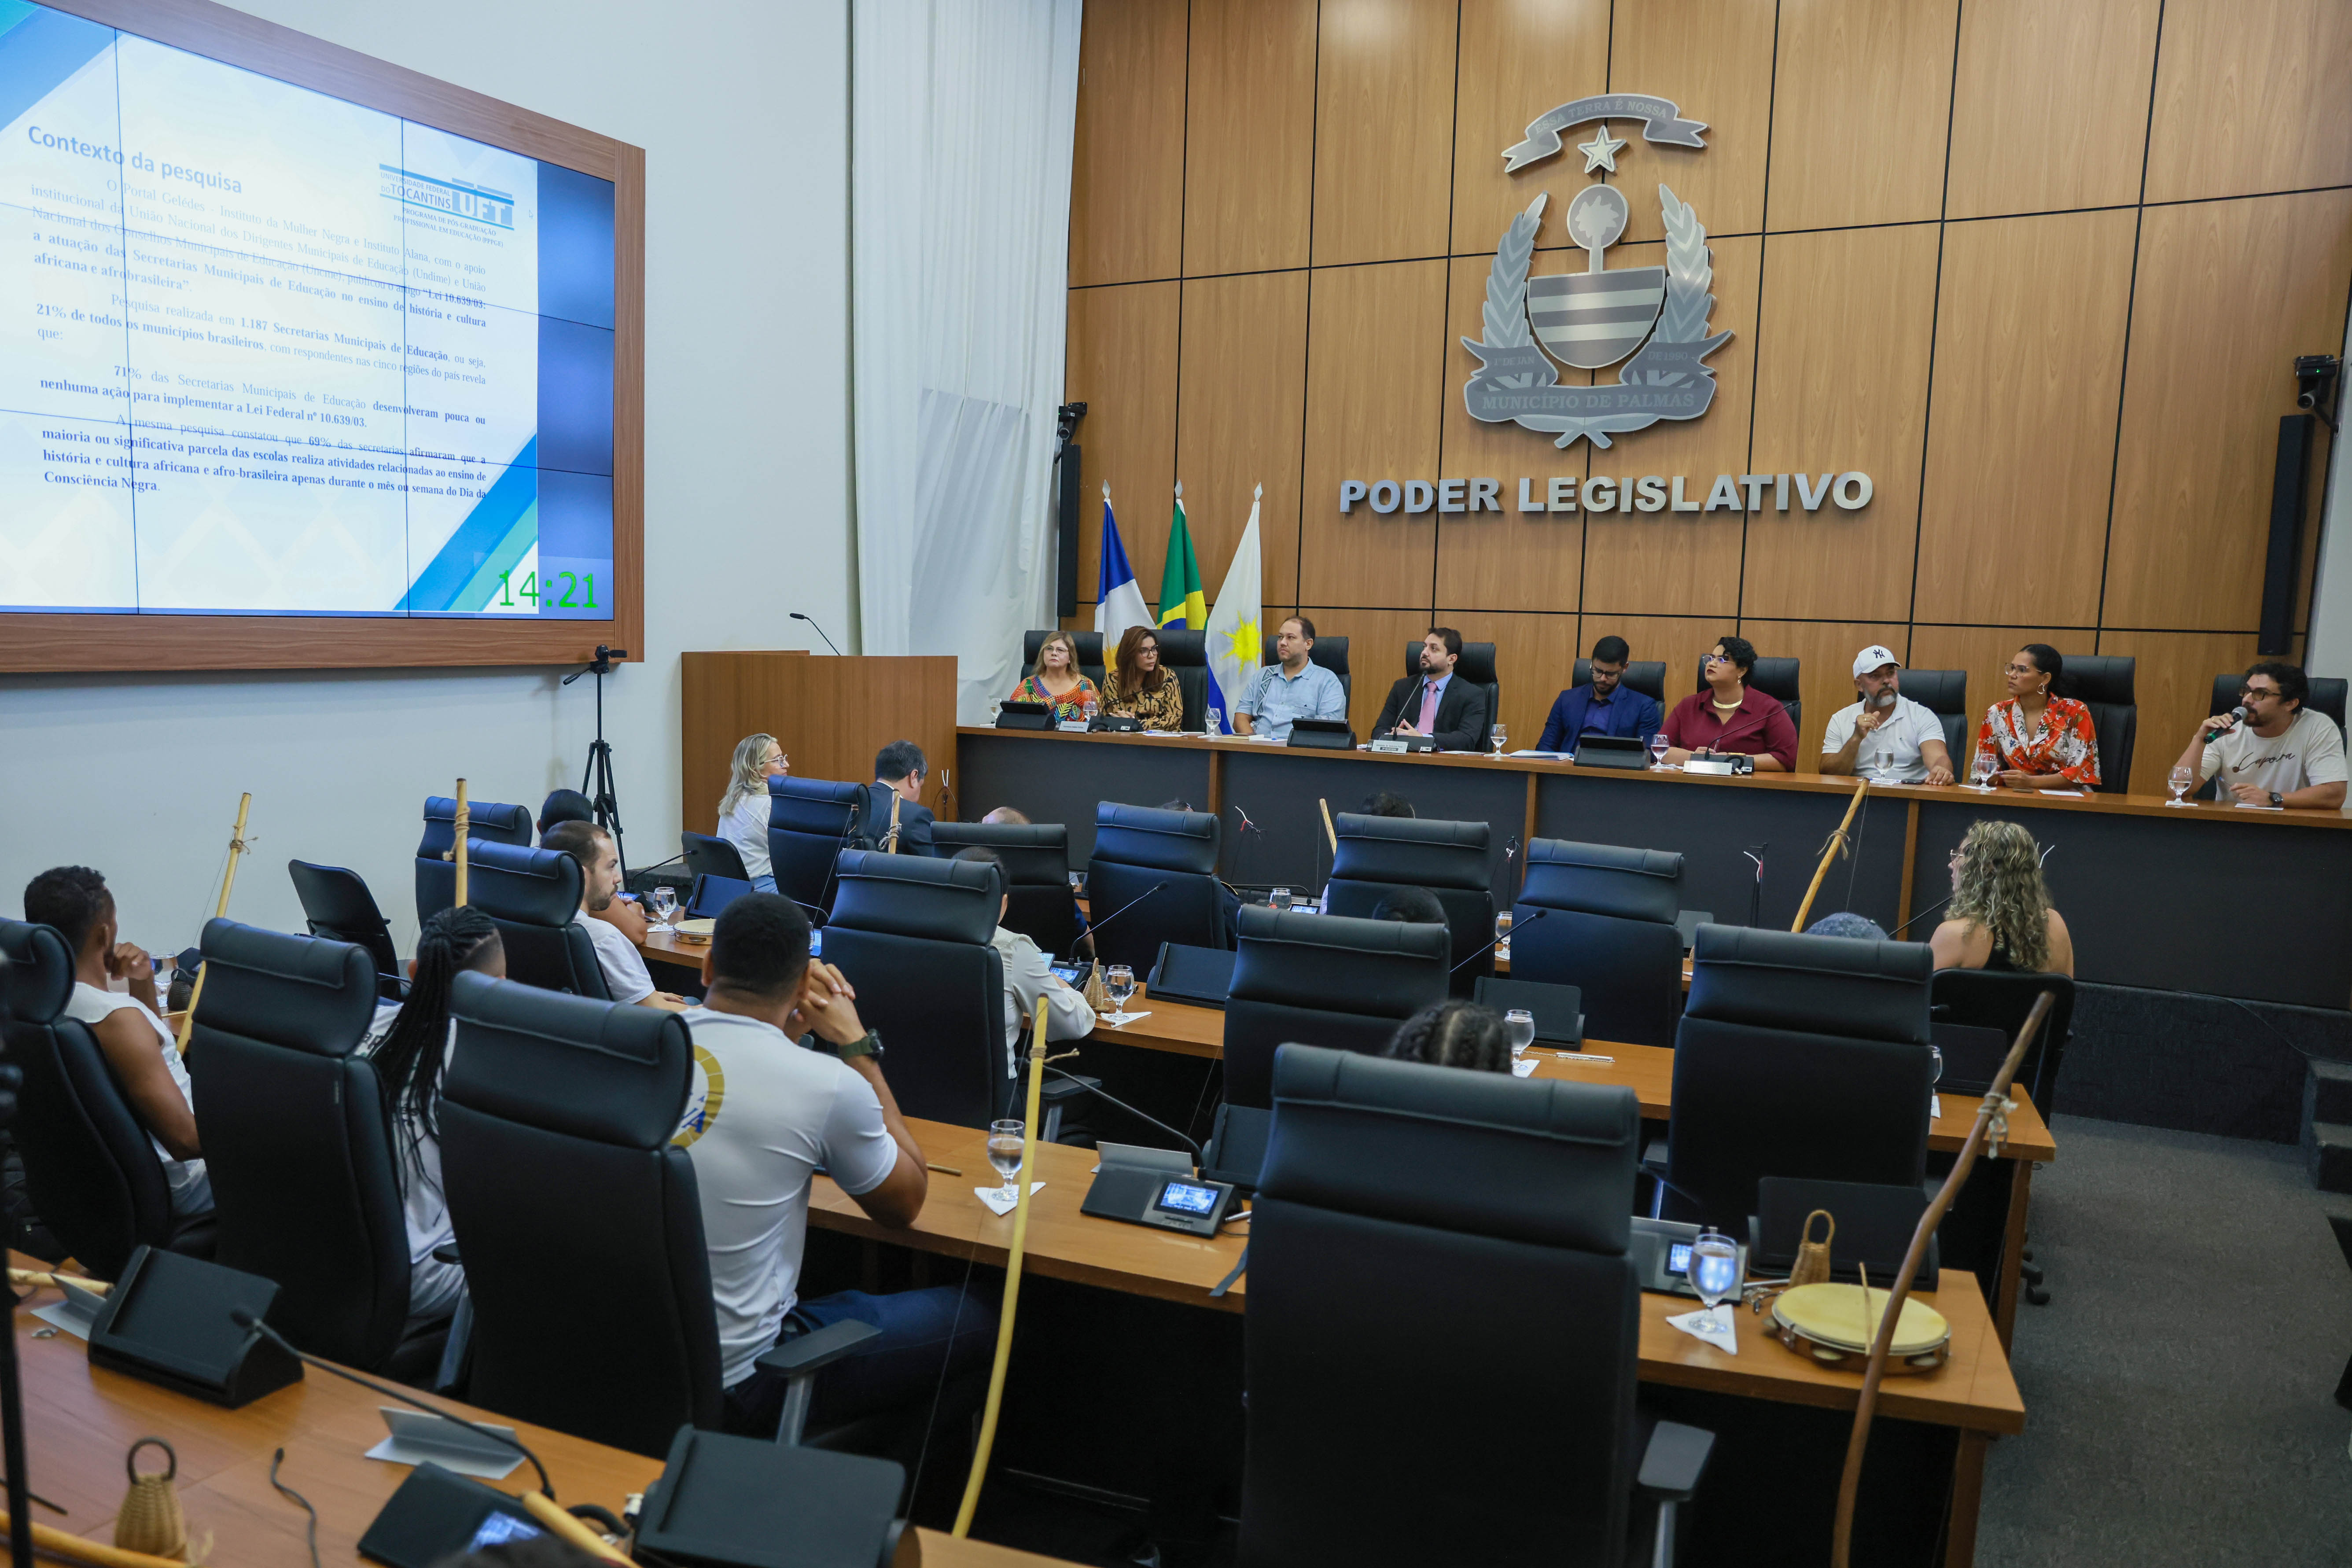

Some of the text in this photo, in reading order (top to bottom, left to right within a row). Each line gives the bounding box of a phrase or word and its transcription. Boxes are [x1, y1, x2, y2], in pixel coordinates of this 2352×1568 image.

[1535, 98, 1667, 134] ESSA TERRA É NOSSA
[28, 125, 241, 194] Contexto da pesquisa
[380, 172, 451, 196] UNIVERSIDADE FEDERAL
[381, 183, 451, 209] DO TOCANTINS
[124, 182, 156, 201] Portal
[220, 204, 261, 224] Instituto
[266, 216, 278, 228] da
[283, 219, 317, 237] Mulher
[322, 228, 350, 245] Negra
[364, 238, 400, 255] Instituto
[404, 247, 431, 264] Alana,
[434, 257, 452, 267] com
[464, 264, 486, 275] apoio
[403, 208, 437, 221] PROGRAMA
[453, 191, 512, 226] UFT
[31, 183, 486, 292] institucional da União Nacional dos Dirigentes Municipais de Educação (Undime) União
[32, 206, 86, 228] Nacional
[90, 219, 110, 233] dos
[114, 224, 172, 247] Conselhos
[175, 236, 234, 260] Municipais
[237, 250, 249, 261] de
[252, 252, 300, 273] Educação
[347, 273, 385, 291] publicou
[396, 283, 420, 298] artigo
[394, 215, 438, 231] PROFISSIONAL
[449, 228, 481, 242] EDUCAÇÃO
[482, 236, 503, 247] (PPPGE)
[33, 252, 88, 272] africana
[48, 234, 486, 327] atuação das Secretarias Municipais de Educação no ensino de história cultura
[36, 303, 486, 384] 21% de todos os municípios brasileiros, com respondentes nas cinco regiões do país revela
[37, 328, 63, 341] que:
[111, 294, 486, 369] Pesquisa realizada em 1.187 Secretarias Municipais de Educação, ou seja,
[40, 379, 367, 427] nenhuma ação para implementar Lei Federal nº 10.639/03.
[114, 365, 143, 379] 71%
[151, 370, 169, 383] das
[177, 374, 234, 391] Secretarias
[242, 383, 296, 401] Municipais
[303, 391, 315, 402] de
[322, 394, 366, 410] Educação
[373, 401, 439, 418] desenvolveram
[444, 412, 471, 423] pouca
[1483, 393, 1694, 409] MUNICÍPIO DE PALMAS
[42, 429, 91, 442] maioria
[95, 436, 110, 444] ou
[114, 435, 184, 452] significativa
[188, 445, 228, 456] parcela
[232, 447, 249, 458] das
[253, 450, 288, 462] escolas
[291, 454, 324, 465] realiza
[328, 457, 375, 470] atividades
[378, 462, 433, 475] relacionadas
[448, 469, 474, 480] ensino
[476, 471, 486, 481] de
[134, 419, 475, 464] mesma pesquisa constatou que 69% das secretarias afirmaram que
[43, 449, 90, 464] história
[106, 456, 149, 470] cultura
[153, 460, 199, 474] africana
[213, 465, 288, 482] afro-brasileira
[291, 475, 325, 486] apenas
[328, 475, 365, 488] durante
[377, 481, 395, 491] mês
[412, 486, 444, 495] semana
[446, 486, 457, 496] do
[460, 487, 473, 497] Dia
[476, 489, 486, 498] da
[44, 471, 160, 493] Consciência Negra.
[1340, 472, 1873, 513] PODER LEGISLATIVO
[499, 570, 598, 608] 14:21
